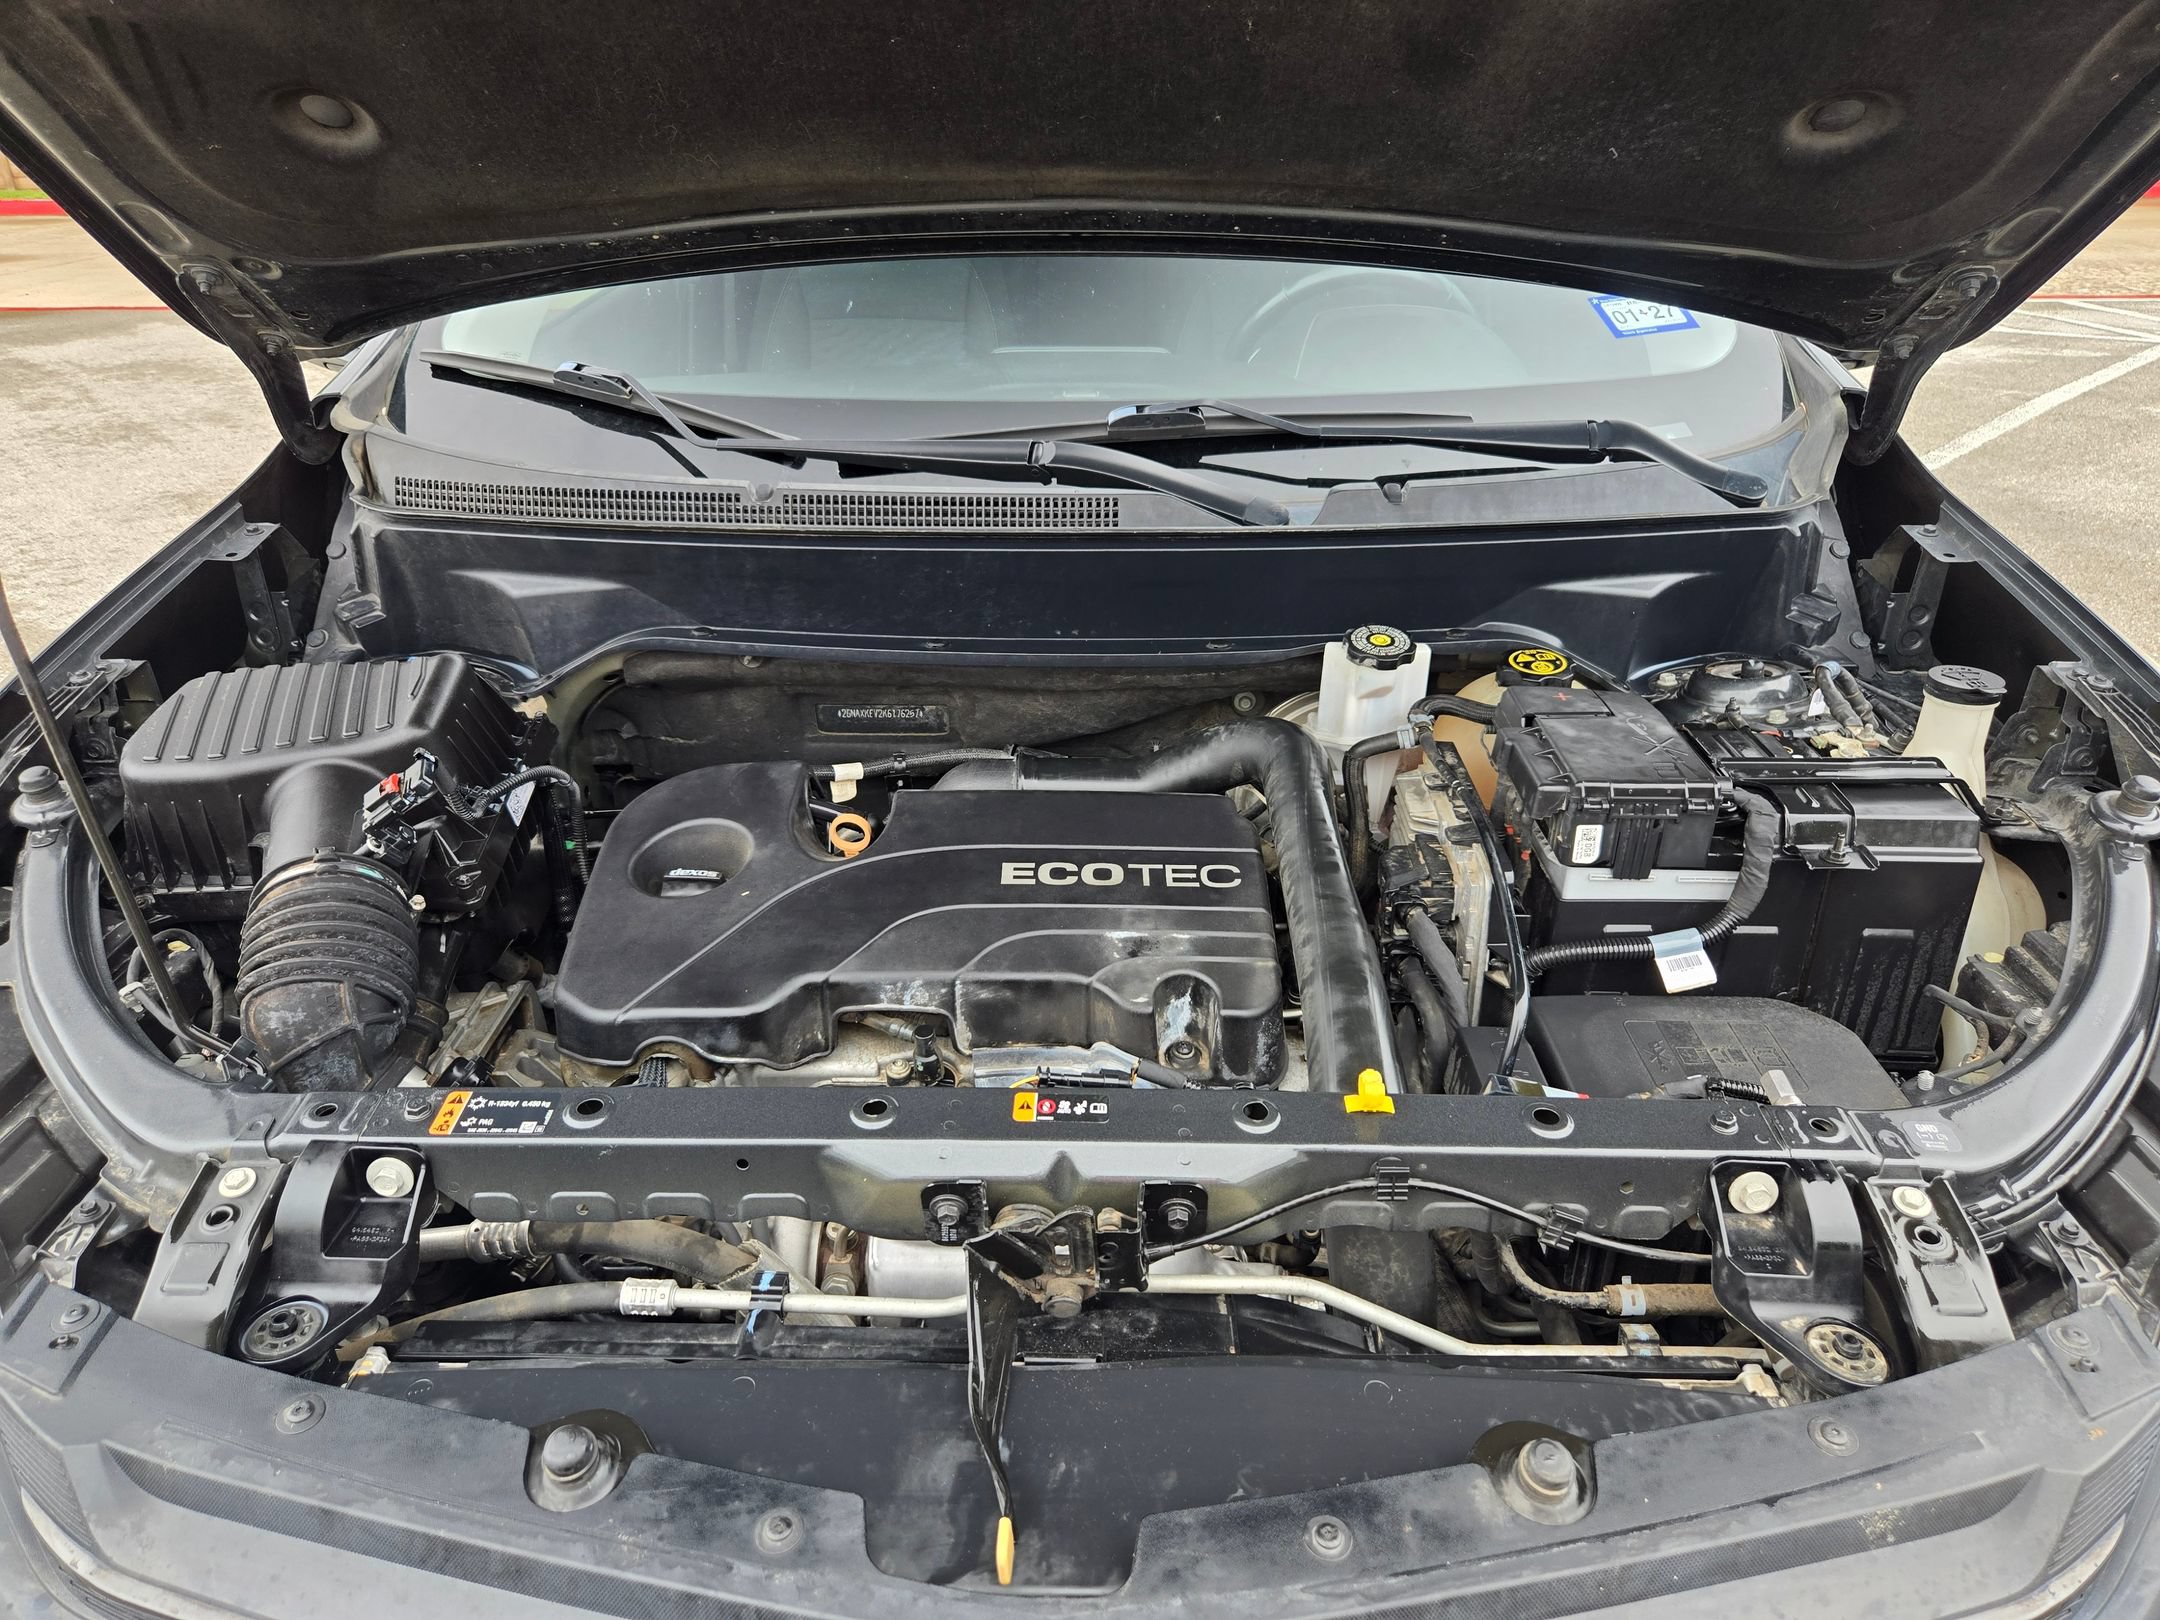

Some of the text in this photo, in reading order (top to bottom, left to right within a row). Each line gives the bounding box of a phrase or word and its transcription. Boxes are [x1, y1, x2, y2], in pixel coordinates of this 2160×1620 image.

[1611, 307, 1640, 325] 01
[668, 867, 721, 878] dexos
[1000, 862, 1242, 888] ECOTEC
